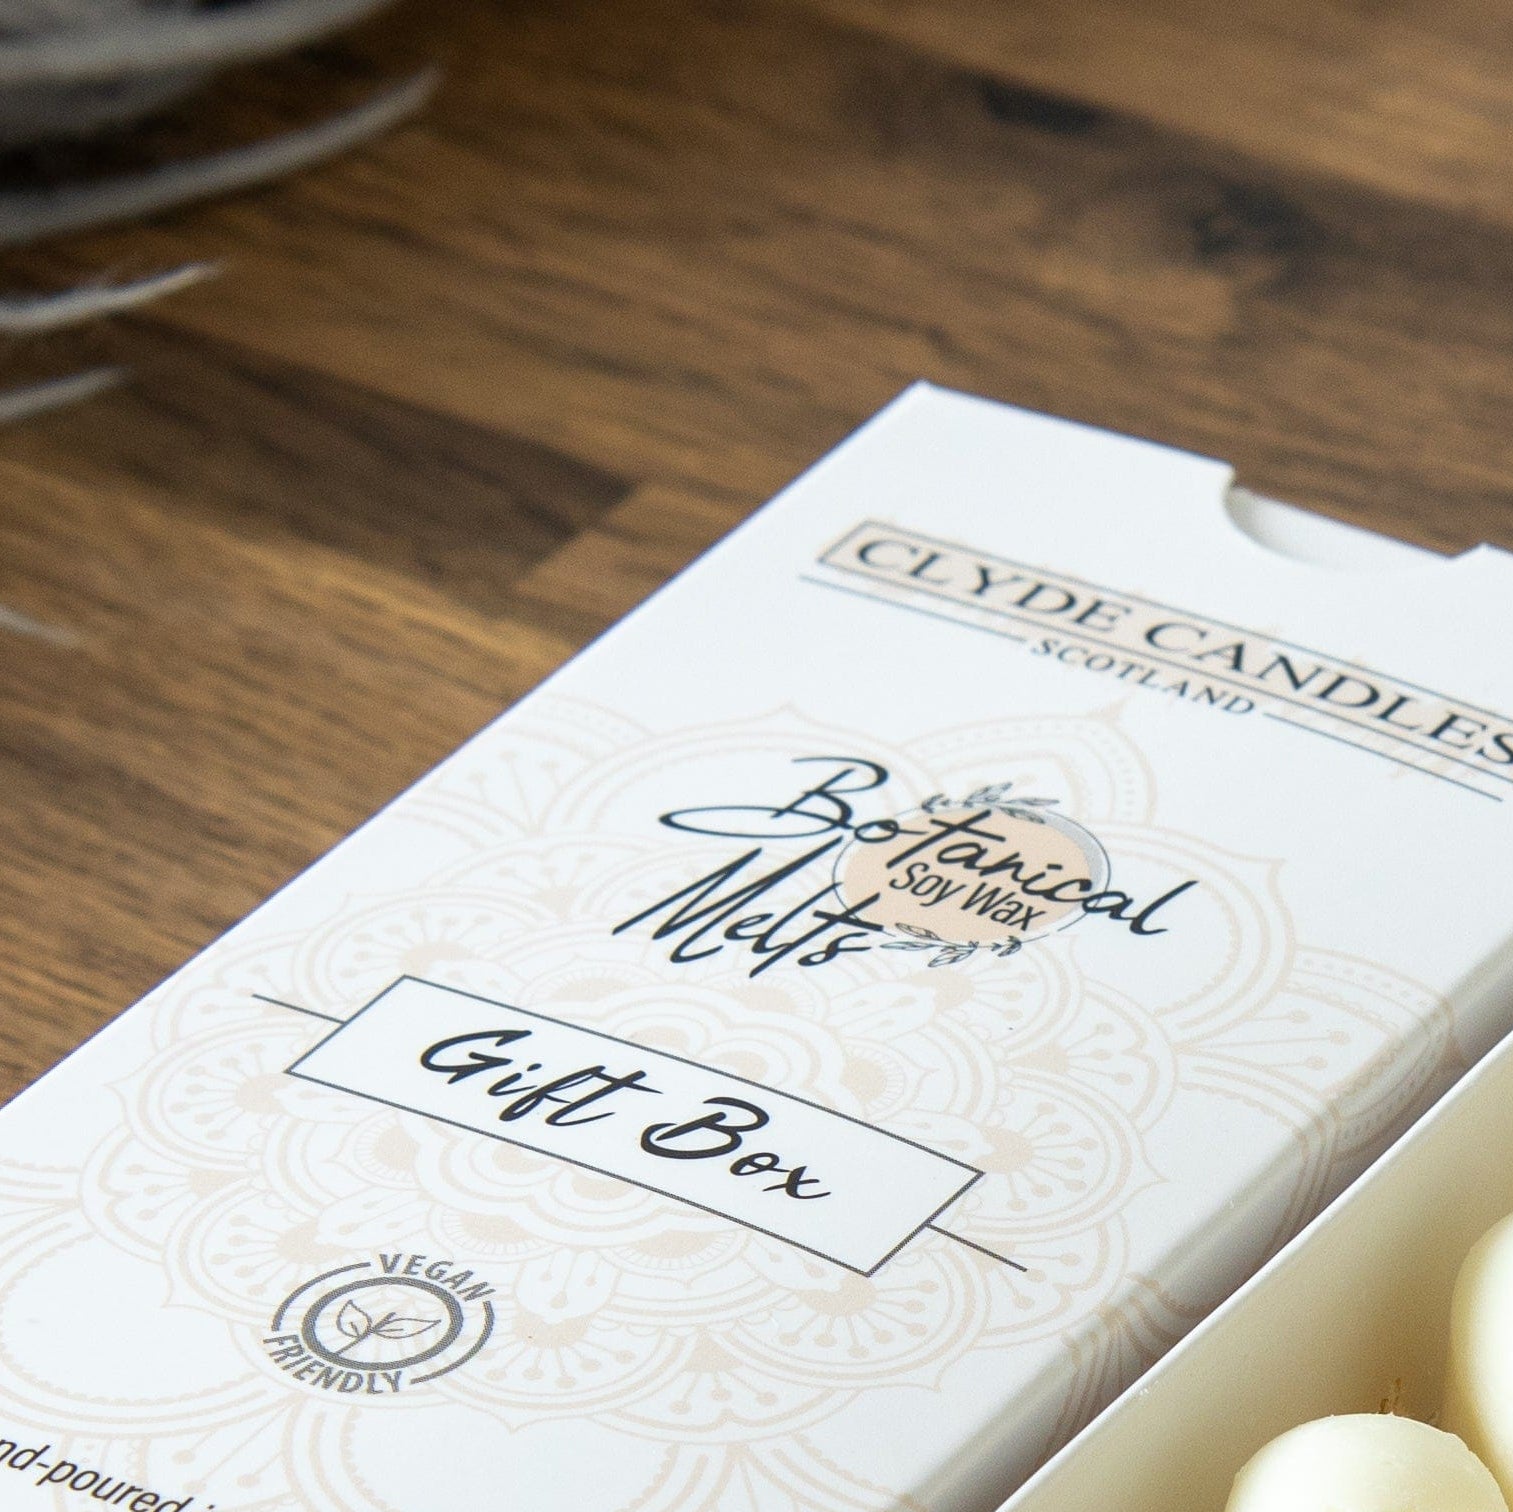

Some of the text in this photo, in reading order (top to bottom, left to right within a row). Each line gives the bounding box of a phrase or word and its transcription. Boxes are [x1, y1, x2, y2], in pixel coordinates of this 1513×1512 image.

[854, 537, 1123, 634] CLYDE
[1031, 637, 1256, 717] SCOTLAND
[658, 757, 1199, 936] Botanical
[611, 836, 885, 979] Melts
[889, 861, 1047, 933] Soy Wax
[420, 1029, 832, 1201] Gift Box
[378, 1253, 496, 1302] VEGAN
[263, 1333, 402, 1395] FRIENDLY
